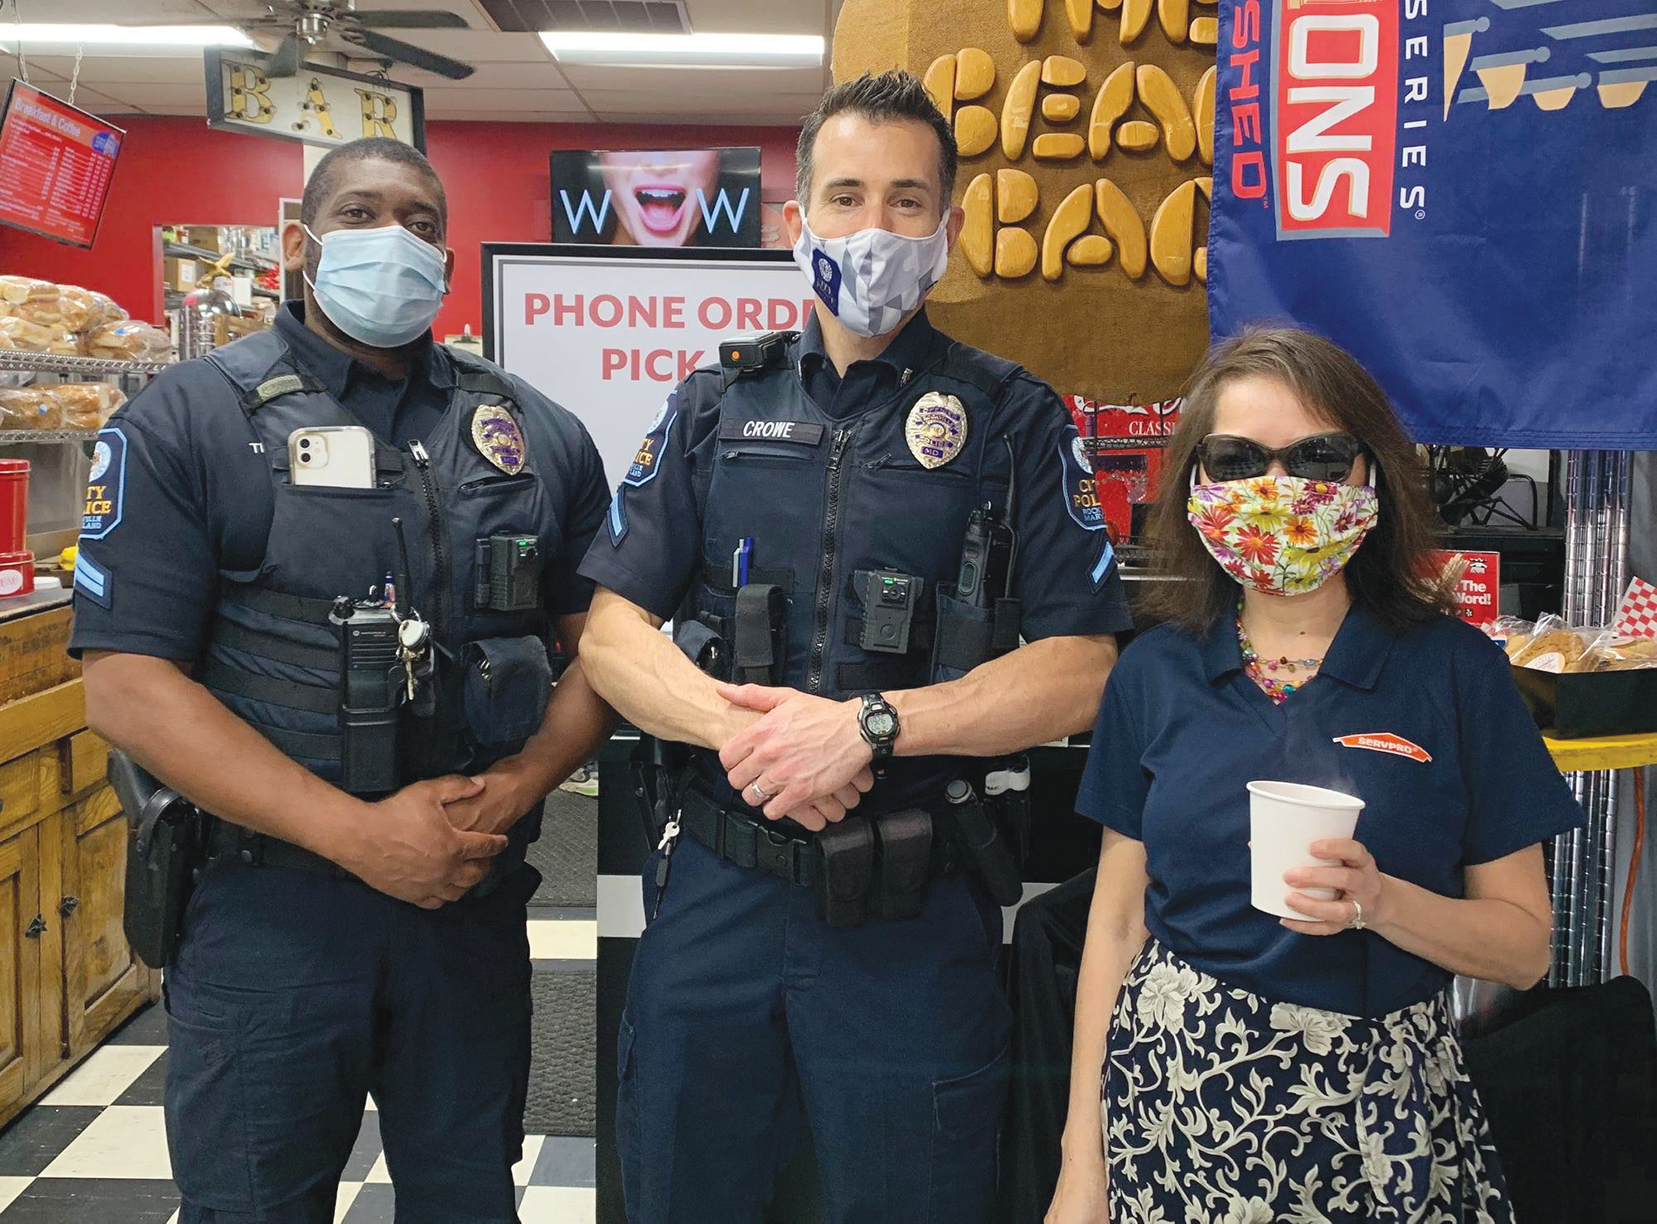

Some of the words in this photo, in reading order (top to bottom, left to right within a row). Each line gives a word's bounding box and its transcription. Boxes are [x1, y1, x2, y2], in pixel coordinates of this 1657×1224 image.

[221, 59, 398, 139] BAR
[524, 293, 686, 329] PHONE
[602, 348, 706, 382] PICK
[743, 420, 796, 438] CROWE
[82, 500, 112, 515] ICE
[1461, 579, 1487, 593] The
